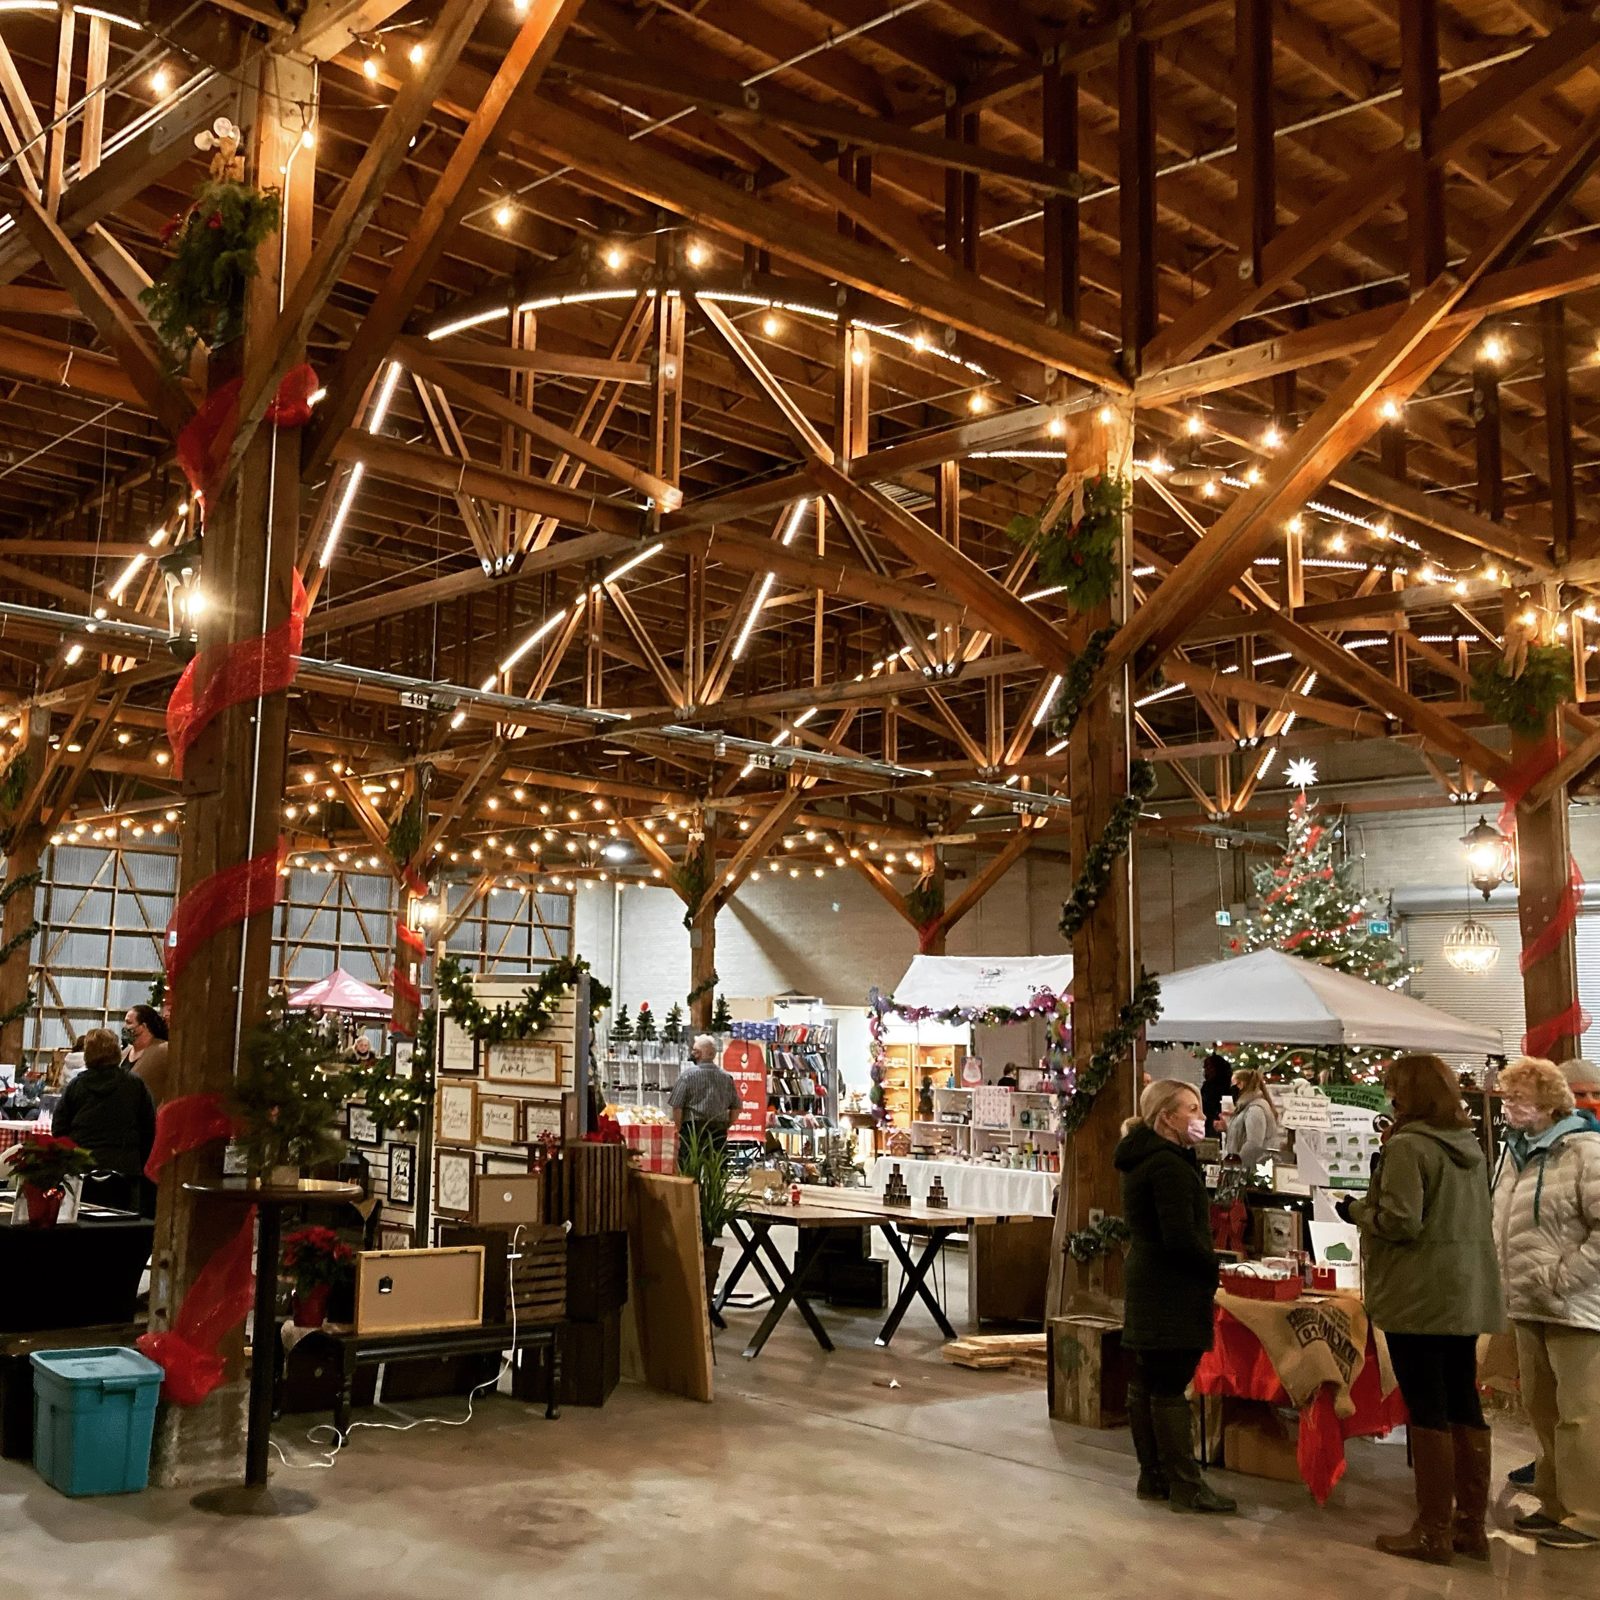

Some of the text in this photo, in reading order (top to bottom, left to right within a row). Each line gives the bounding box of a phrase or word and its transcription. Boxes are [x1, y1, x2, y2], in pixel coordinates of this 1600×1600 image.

[407, 692, 424, 706] 48
[1325, 1090, 1347, 1098] Good
[1350, 1092, 1379, 1105] Coffee
